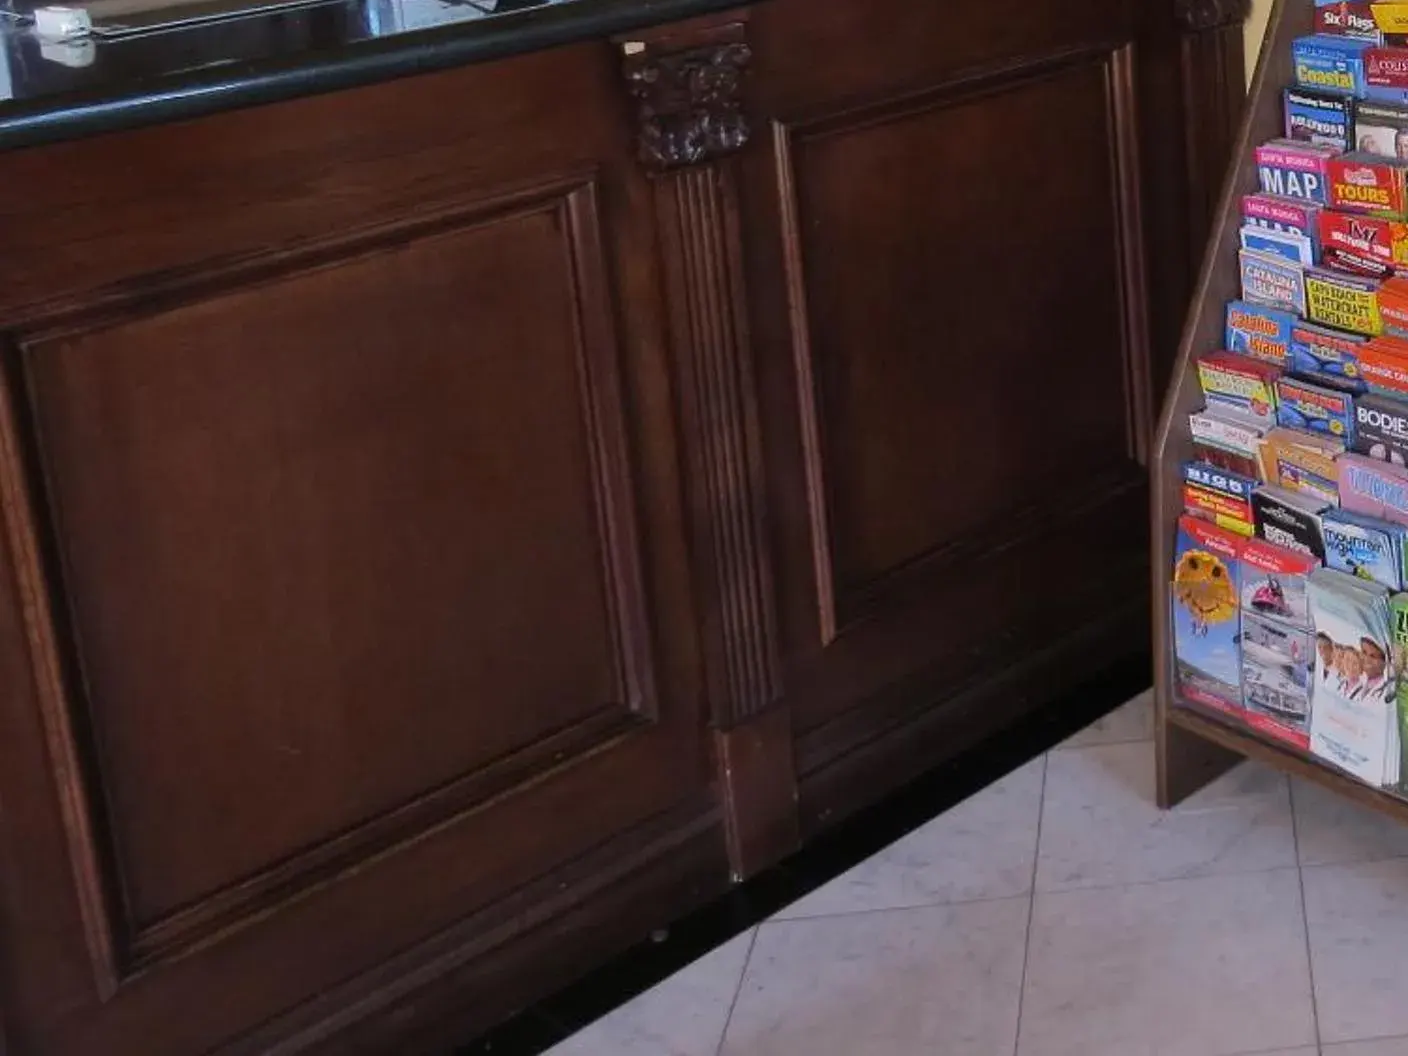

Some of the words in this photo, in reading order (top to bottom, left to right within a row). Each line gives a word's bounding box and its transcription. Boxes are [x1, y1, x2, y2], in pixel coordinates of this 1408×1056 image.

[1324, 12, 1341, 26] Six
[1260, 167, 1317, 195] MAP
[1335, 184, 1390, 204] TOURS
